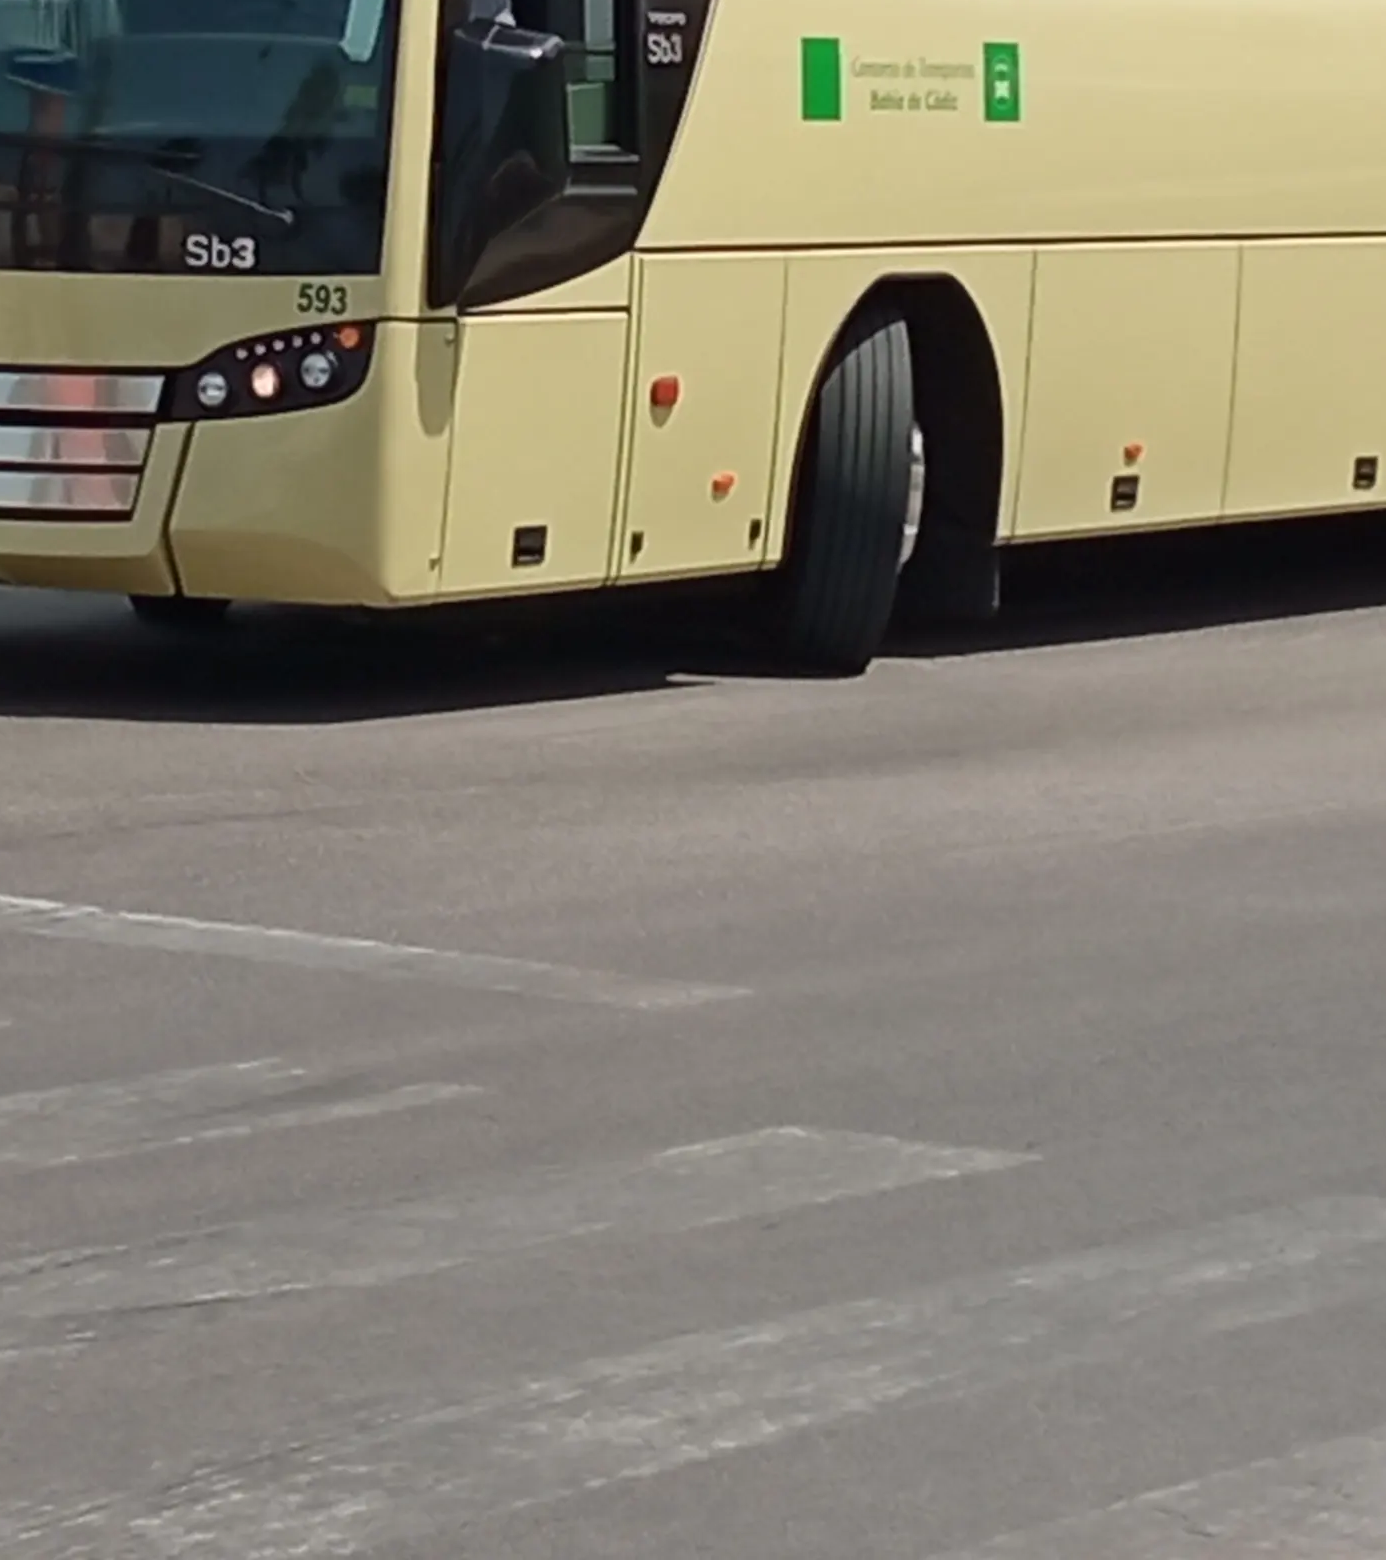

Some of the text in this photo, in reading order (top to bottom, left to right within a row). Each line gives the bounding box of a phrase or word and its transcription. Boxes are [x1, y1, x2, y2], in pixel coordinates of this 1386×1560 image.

[647, 32, 683, 65] Sb3
[184, 234, 256, 270] Sb3
[296, 283, 349, 317] 593
